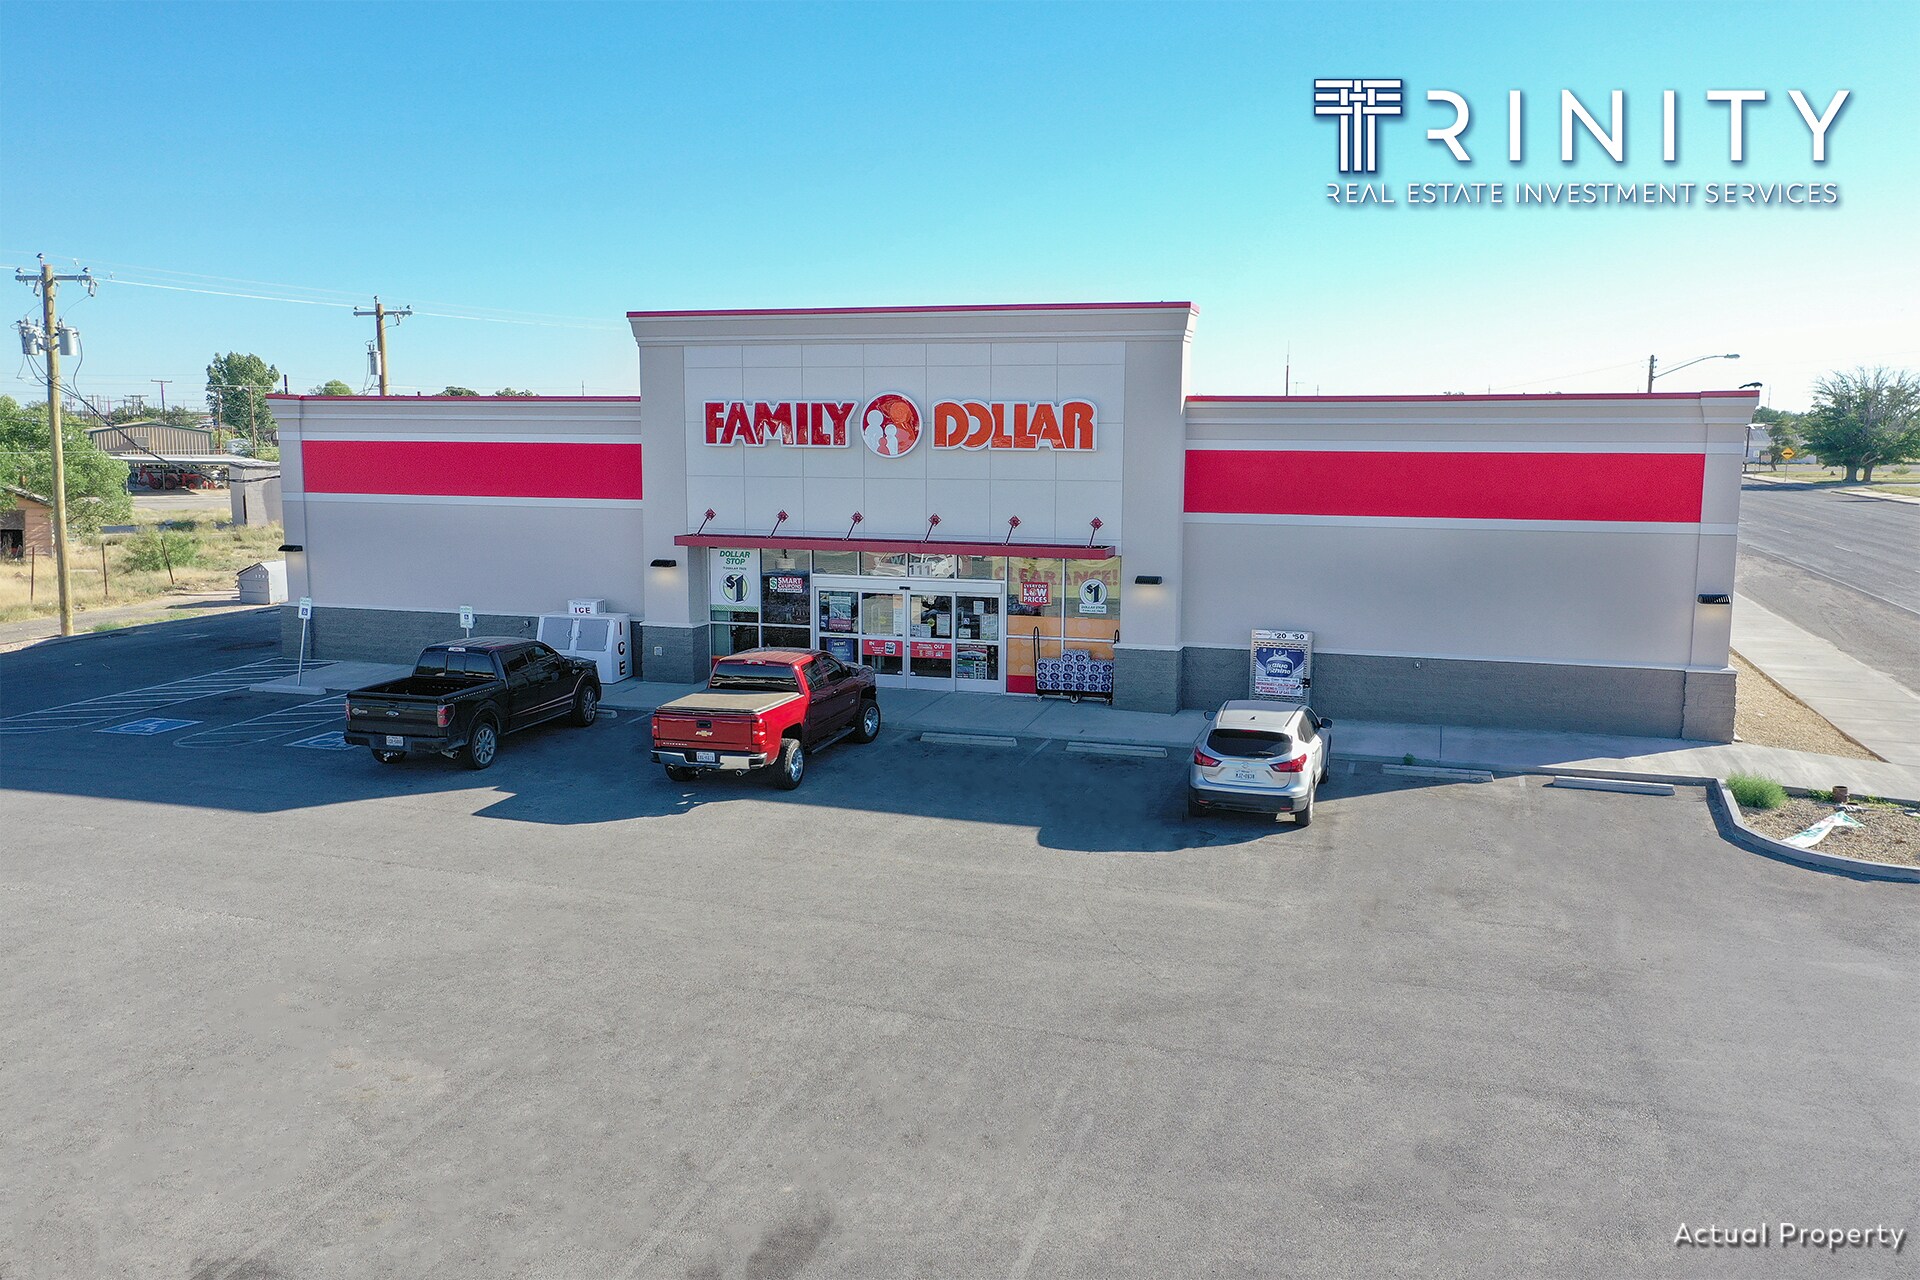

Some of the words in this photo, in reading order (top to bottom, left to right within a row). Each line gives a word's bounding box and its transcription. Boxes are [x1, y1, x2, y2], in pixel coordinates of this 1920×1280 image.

[703, 401, 857, 446] FAMILY
[933, 401, 1095, 450] DOLLAR
[719, 550, 751, 558] DOLLAR
[725, 574, 745, 602] $1
[1086, 583, 1100, 603] $1
